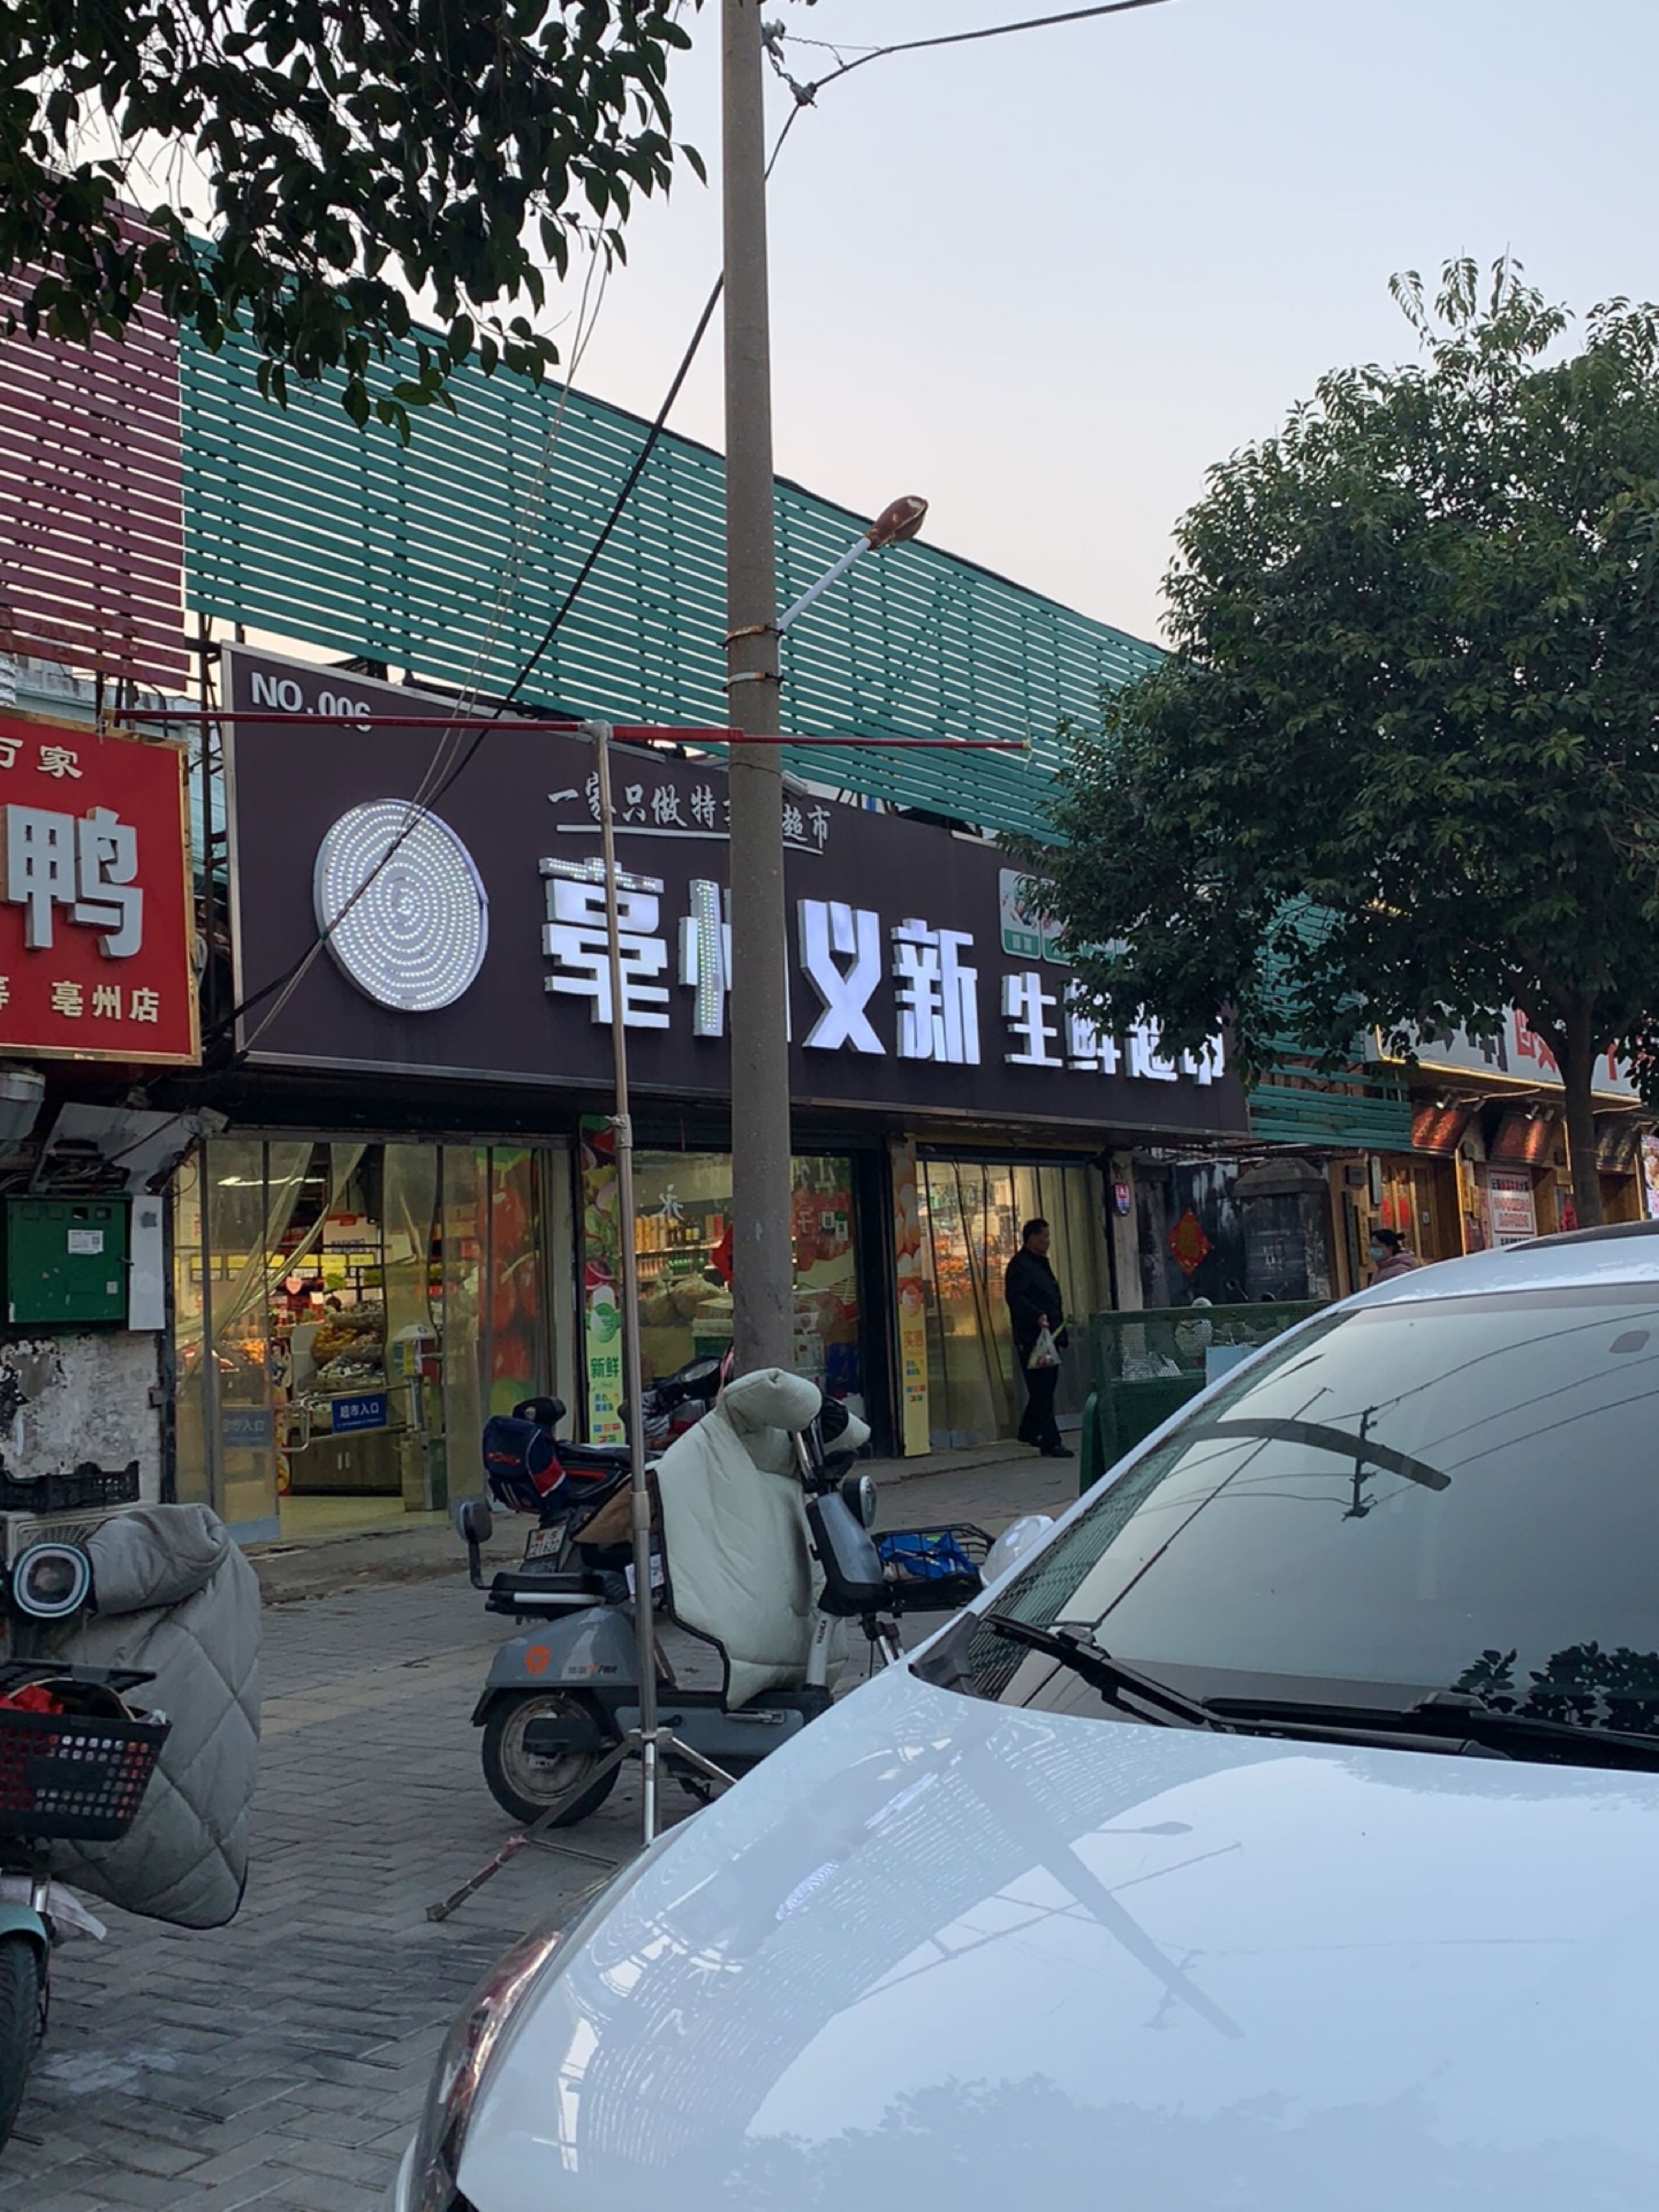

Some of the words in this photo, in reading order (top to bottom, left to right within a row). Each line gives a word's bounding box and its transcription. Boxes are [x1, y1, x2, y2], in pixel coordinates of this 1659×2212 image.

[1, 804, 143, 958] 鸭
[590, 1356, 620, 1379] 新鲜
[340, 1401, 380, 1419] 超市入口
